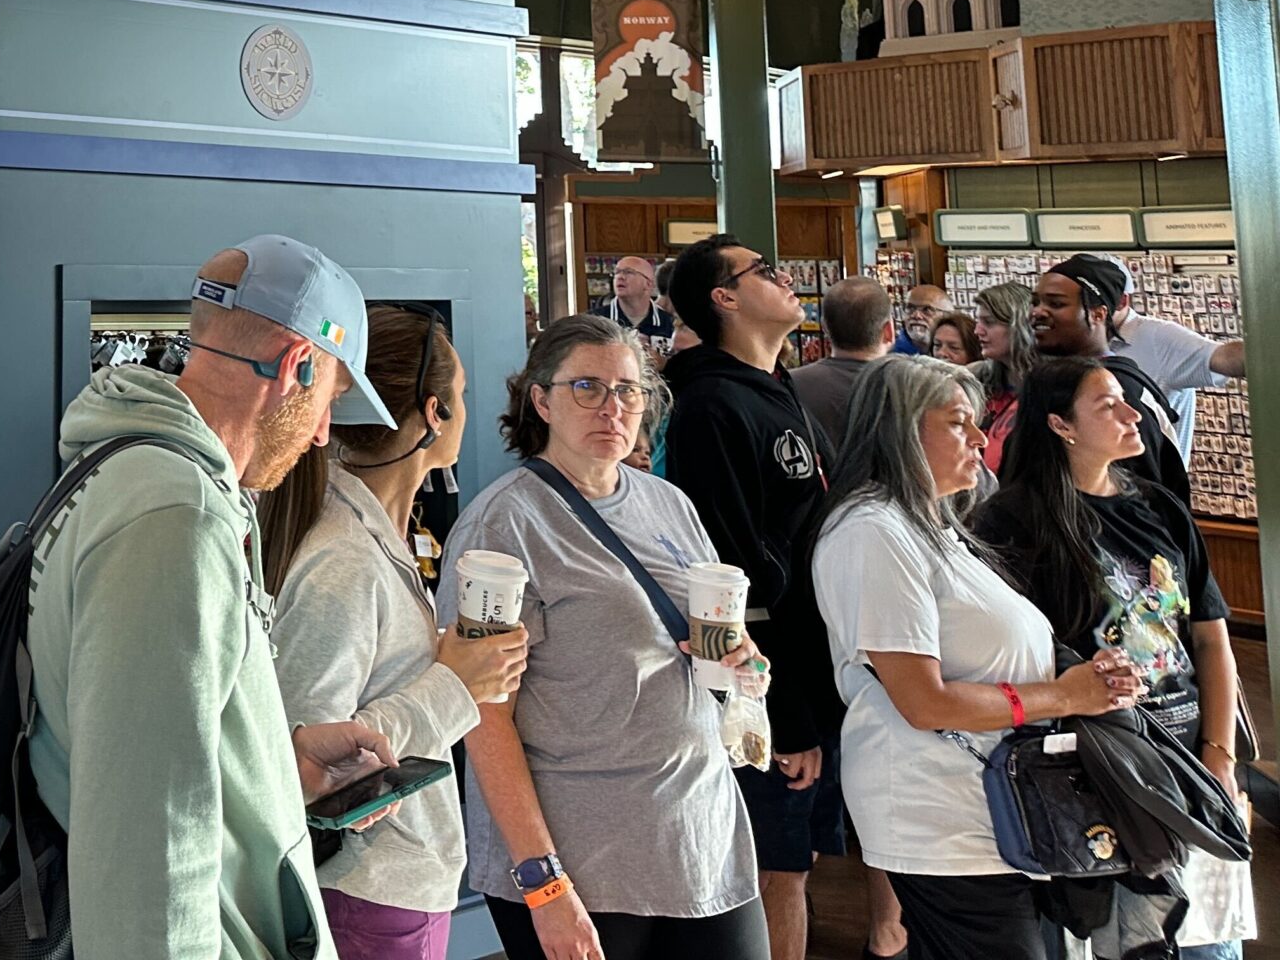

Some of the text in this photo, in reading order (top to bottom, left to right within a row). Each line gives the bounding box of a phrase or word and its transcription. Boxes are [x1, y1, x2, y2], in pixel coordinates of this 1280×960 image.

[623, 16, 670, 25] NORWAY
[253, 33, 299, 55] WORLD
[481, 590, 489, 622] ARBUCKS
